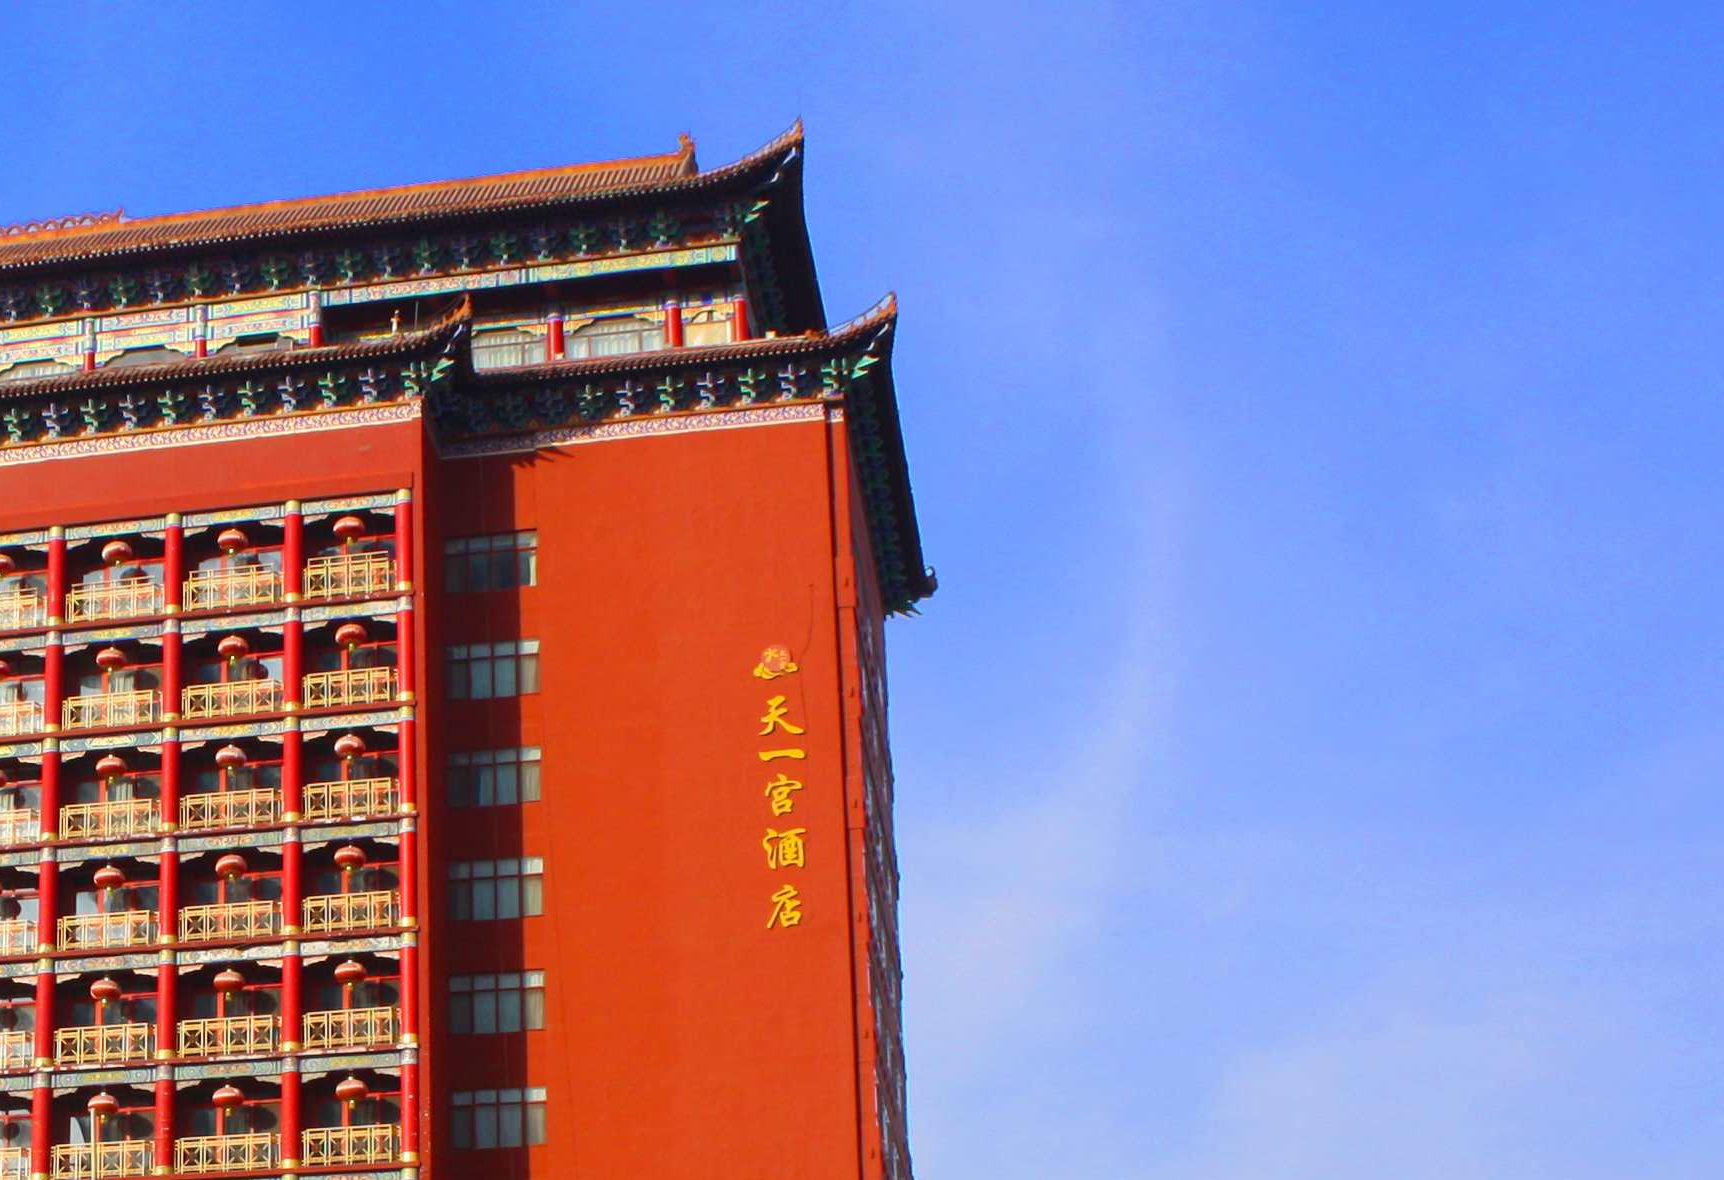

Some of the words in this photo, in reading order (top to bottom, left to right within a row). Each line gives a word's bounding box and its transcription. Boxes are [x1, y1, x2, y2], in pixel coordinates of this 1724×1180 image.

[758, 694, 807, 929] 天一宫酒店
